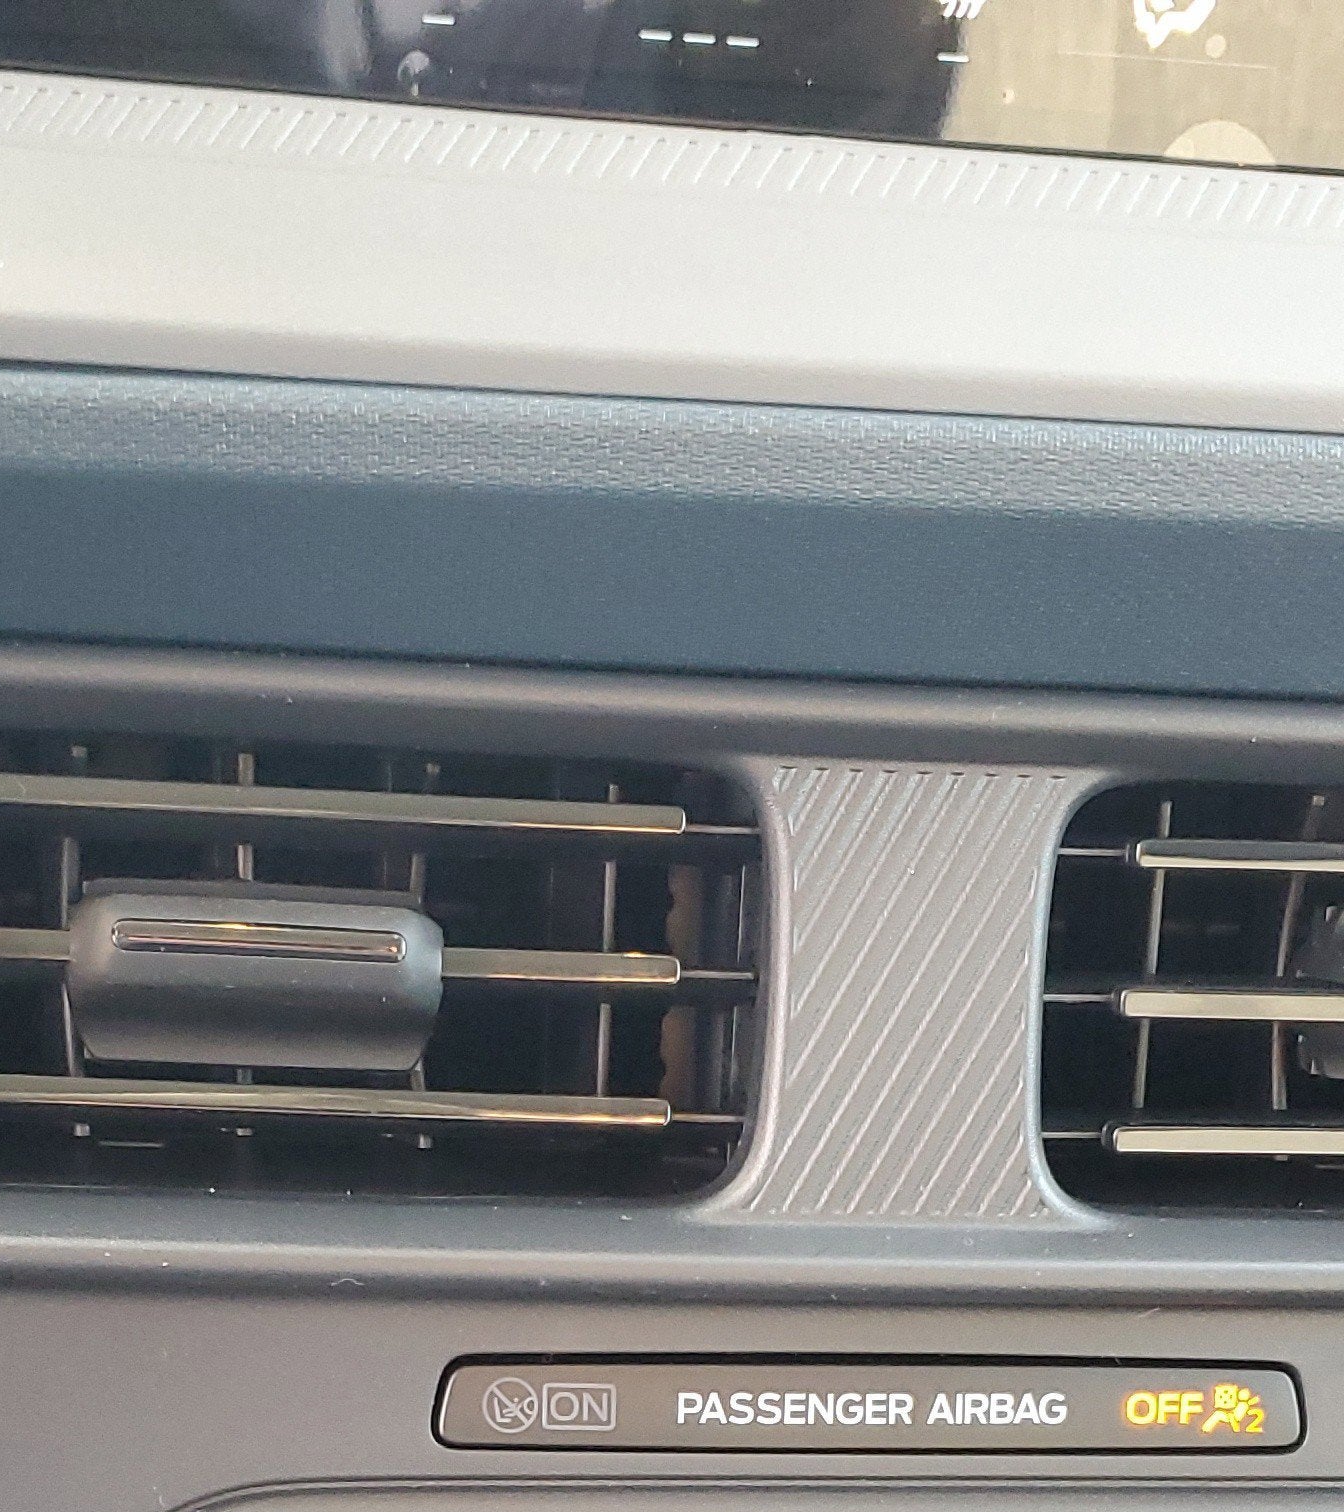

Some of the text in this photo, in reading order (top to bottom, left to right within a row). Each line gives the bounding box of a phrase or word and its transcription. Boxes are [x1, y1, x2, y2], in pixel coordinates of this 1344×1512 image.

[549, 1391, 608, 1422] ON
[676, 1391, 913, 1425] PASSENGER
[926, 1391, 1068, 1425] AIRBAG
[1125, 1390, 1204, 1426] OFF
